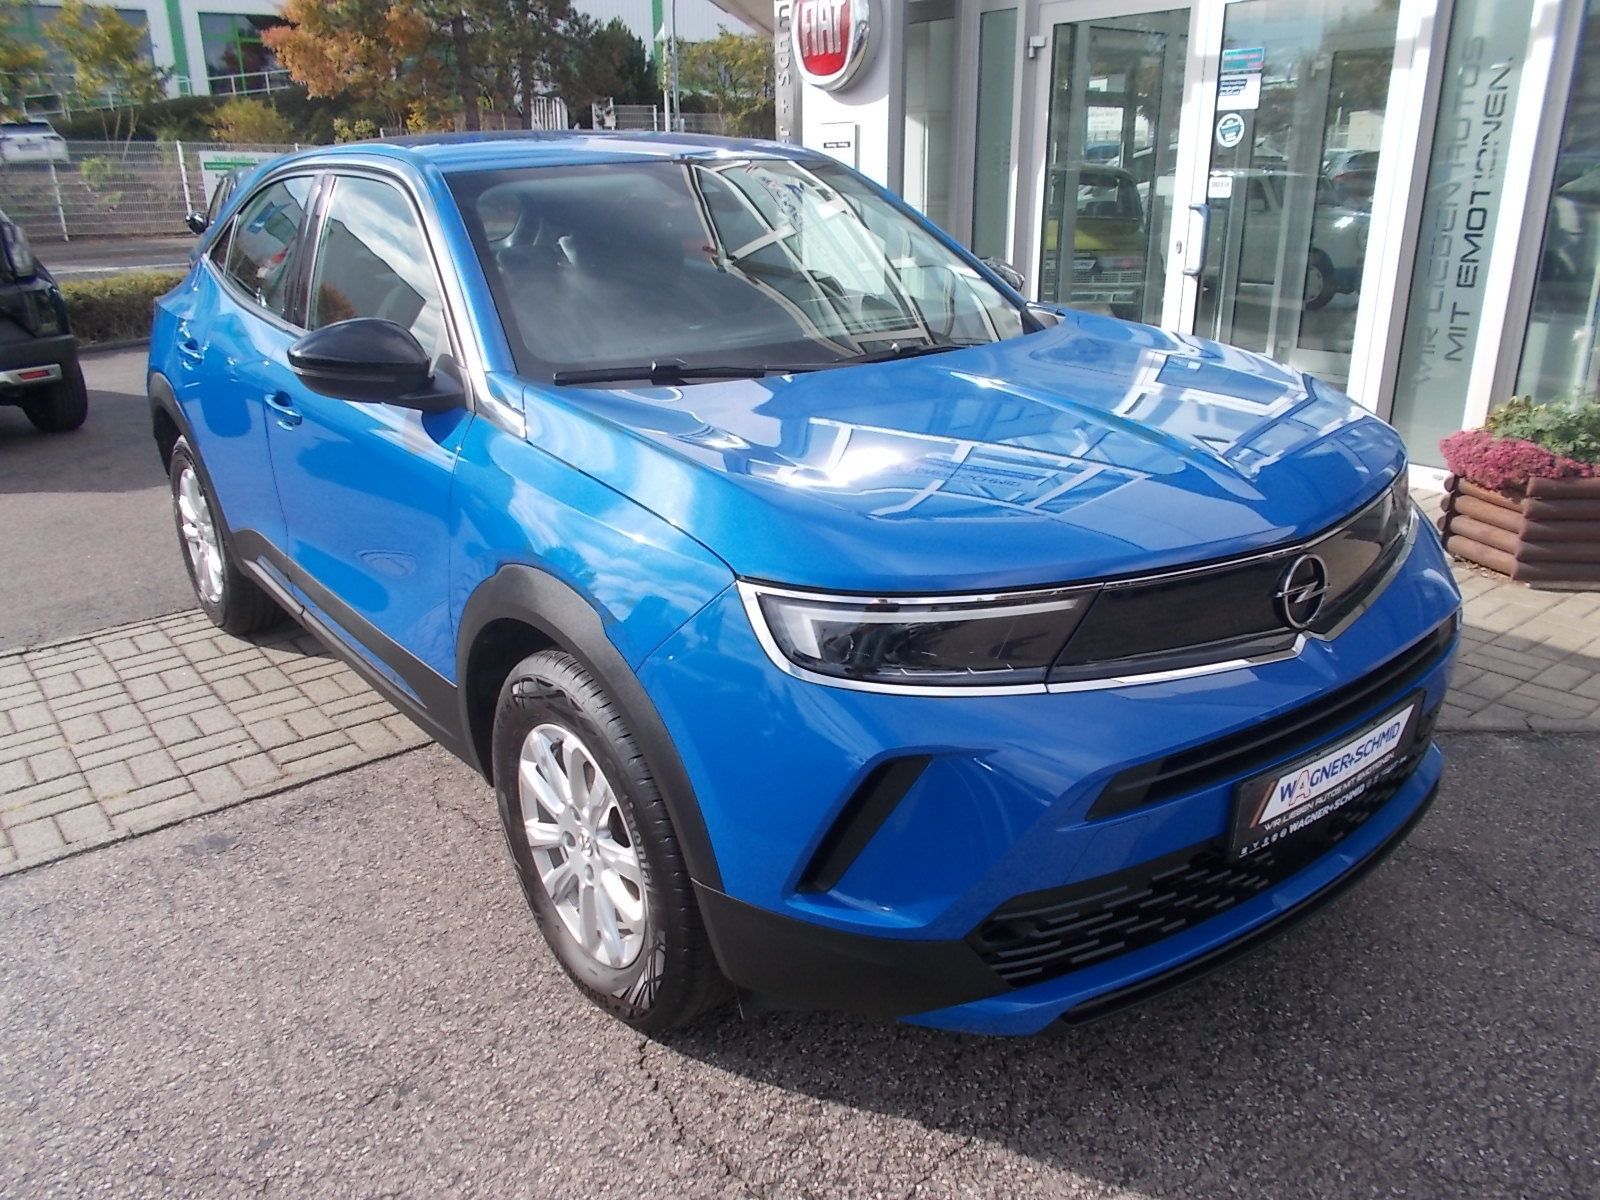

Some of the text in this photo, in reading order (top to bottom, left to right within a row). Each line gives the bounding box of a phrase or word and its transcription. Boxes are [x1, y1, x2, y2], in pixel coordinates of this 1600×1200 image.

[778, 0, 791, 86] Schm
[801, 0, 846, 57] FIAT
[1446, 36, 1485, 168] AUTOS
[1444, 302, 1470, 362] MIT
